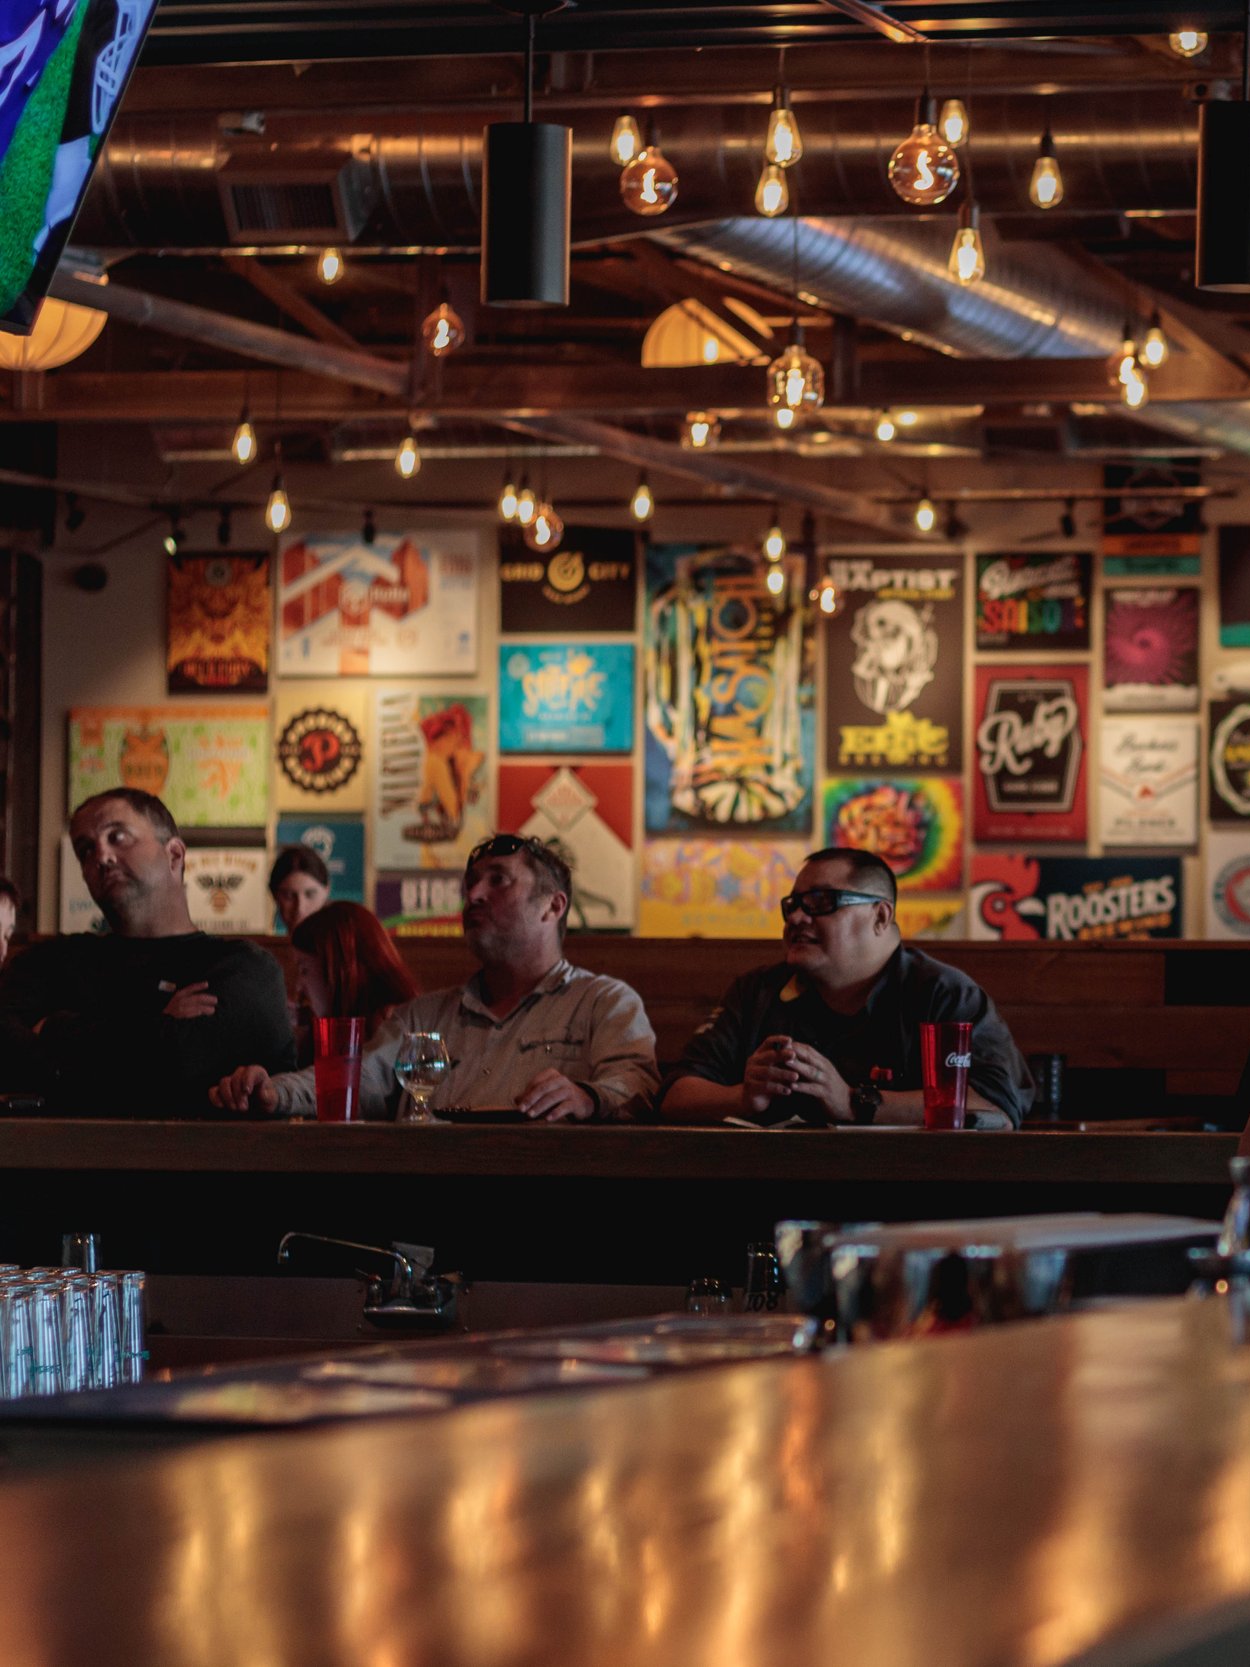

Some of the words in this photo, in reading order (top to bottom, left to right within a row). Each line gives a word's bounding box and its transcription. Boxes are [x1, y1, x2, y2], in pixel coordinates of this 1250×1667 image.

[501, 564, 543, 580] GRID
[589, 563, 629, 580] CITY
[978, 697, 1077, 774] Ruby
[1047, 876, 1175, 940] ROOSTERS
